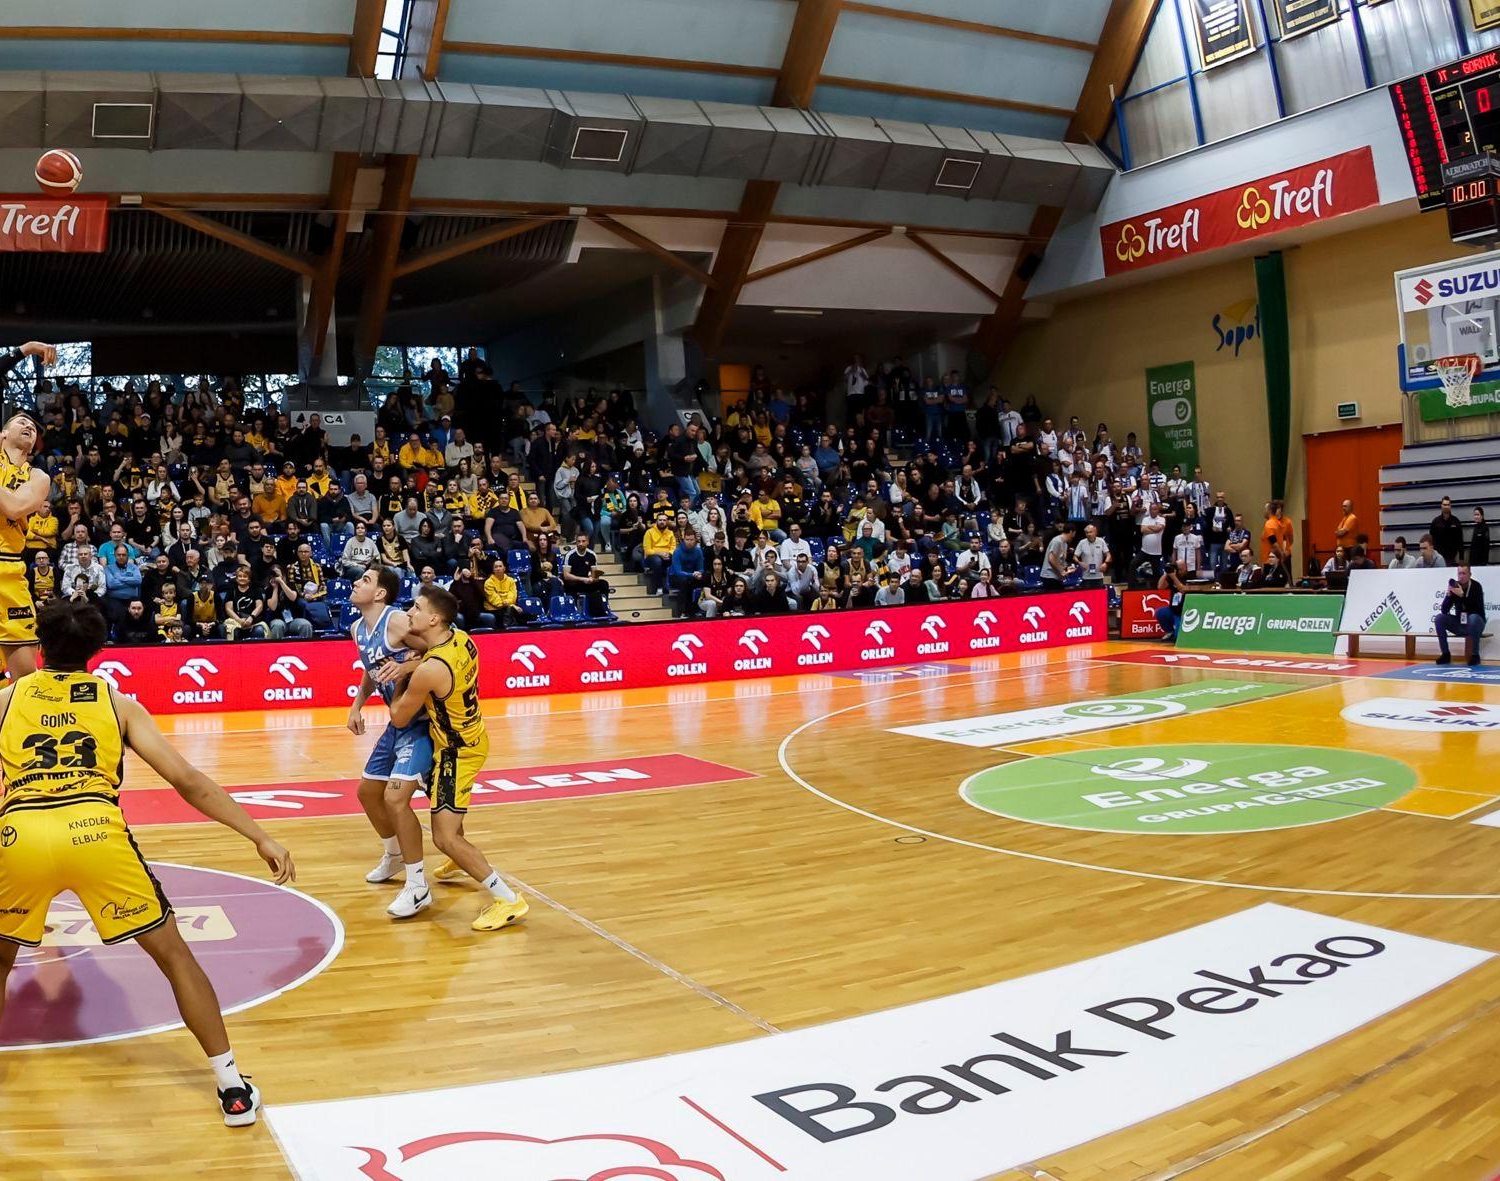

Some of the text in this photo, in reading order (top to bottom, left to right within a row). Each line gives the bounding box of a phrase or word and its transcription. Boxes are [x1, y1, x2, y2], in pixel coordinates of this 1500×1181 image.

[1462, 53, 1498, 74] GORNIK
[1477, 88, 1492, 112] 0
[1465, 131, 1471, 142] 2
[1445, 158, 1488, 177] AEROWATCH
[1269, 168, 1333, 218] Trefl
[1453, 181, 1485, 202] 10.00
[0, 204, 80, 242] Trefl
[1144, 207, 1200, 254] Trefl
[1438, 269, 1500, 298] SUZU
[1150, 379, 1191, 405] Energa
[1471, 393, 1495, 404] RUPA
[324, 415, 343, 423] C4
[353, 547, 370, 556] GAP
[1360, 599, 1389, 631] LEROY
[1387, 591, 1413, 632] MERLIN
[1132, 624, 1154, 633] Bank
[1202, 612, 1331, 635] Energa GRUPA ORLEN
[1019, 630, 1048, 643] ORLEN
[1066, 625, 1093, 638] ORLEN
[917, 641, 949, 654] ORLEN
[970, 636, 1000, 649] ORLEN
[367, 646, 385, 664] 24
[797, 652, 833, 665] ORLEN
[861, 647, 894, 660] ORLEN
[667, 662, 707, 676] ORLEN
[734, 657, 772, 670] ORLEN
[1212, 658, 1357, 671] ORLEN
[506, 674, 550, 688] ORLEN
[581, 669, 623, 683] ORLEN
[173, 690, 223, 704] ORLEN
[264, 688, 312, 700] ORLEN
[40, 712, 77, 728] GOINS
[940, 715, 1077, 738] Energa
[1362, 713, 1499, 727] SUZUKI
[21, 731, 98, 770] 33
[1082, 766, 1329, 808] Energa
[1137, 778, 1380, 822] GRUPA ORLEN
[68, 816, 111, 831] KNEDLER
[754, 934, 1387, 1145] Bank Pekao
